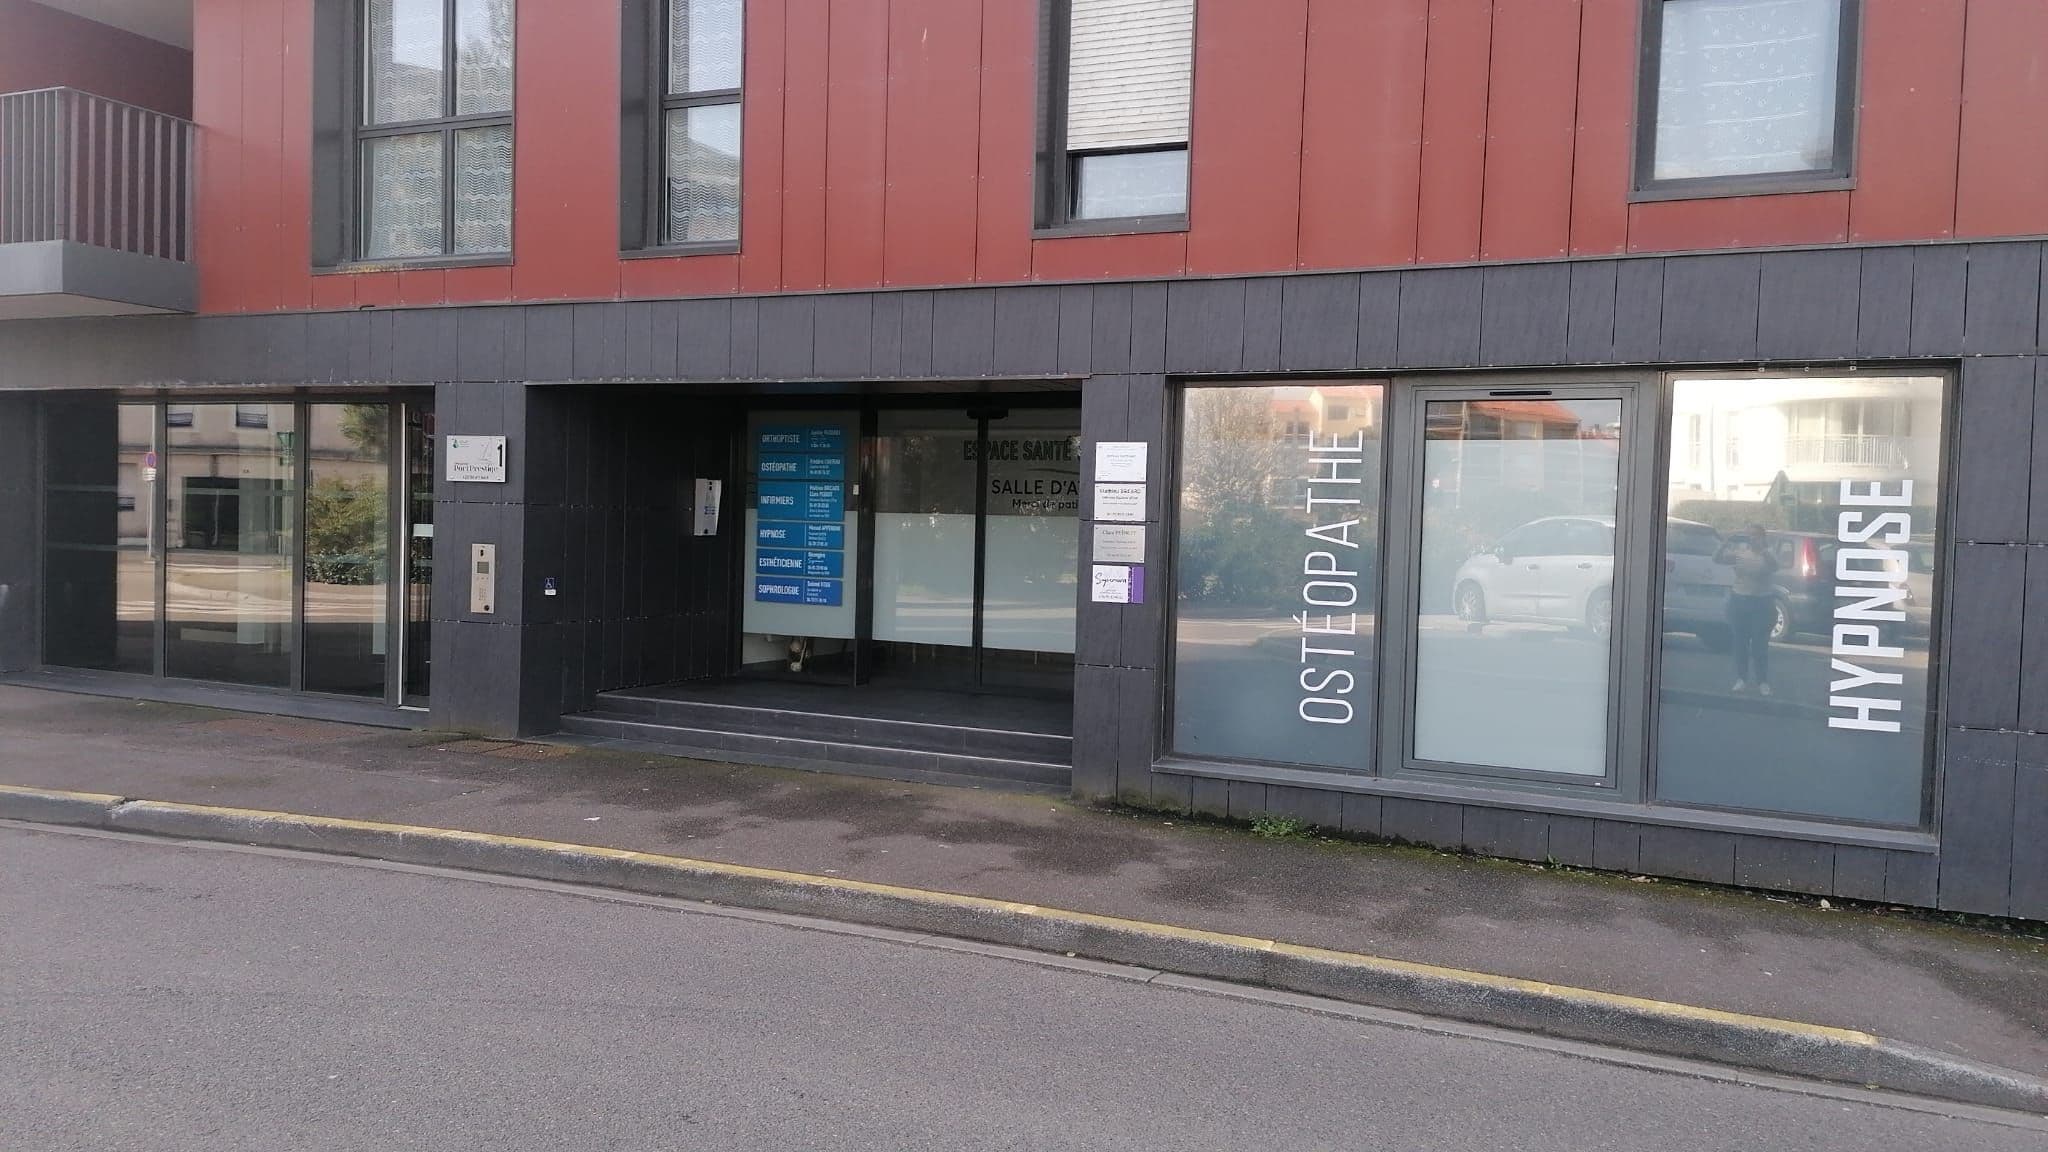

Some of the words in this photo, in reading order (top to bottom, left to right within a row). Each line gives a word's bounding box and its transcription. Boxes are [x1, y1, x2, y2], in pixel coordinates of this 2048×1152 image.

[761, 433, 801, 444] ORTHOPTISTE
[497, 444, 503, 467] 1
[761, 461, 798, 473] OSTÉOPATHE
[991, 480, 1043, 495] SALLE
[760, 495, 795, 505] INFIRMIERS
[759, 529, 787, 539] HYPNOSE
[759, 556, 803, 569] ESTHÉTICIENNE
[1293, 430, 1363, 725] OSTÉOPATHE
[758, 584, 800, 596] SOPHROLOGUE
[1828, 479, 1913, 733] HYPNOSE
